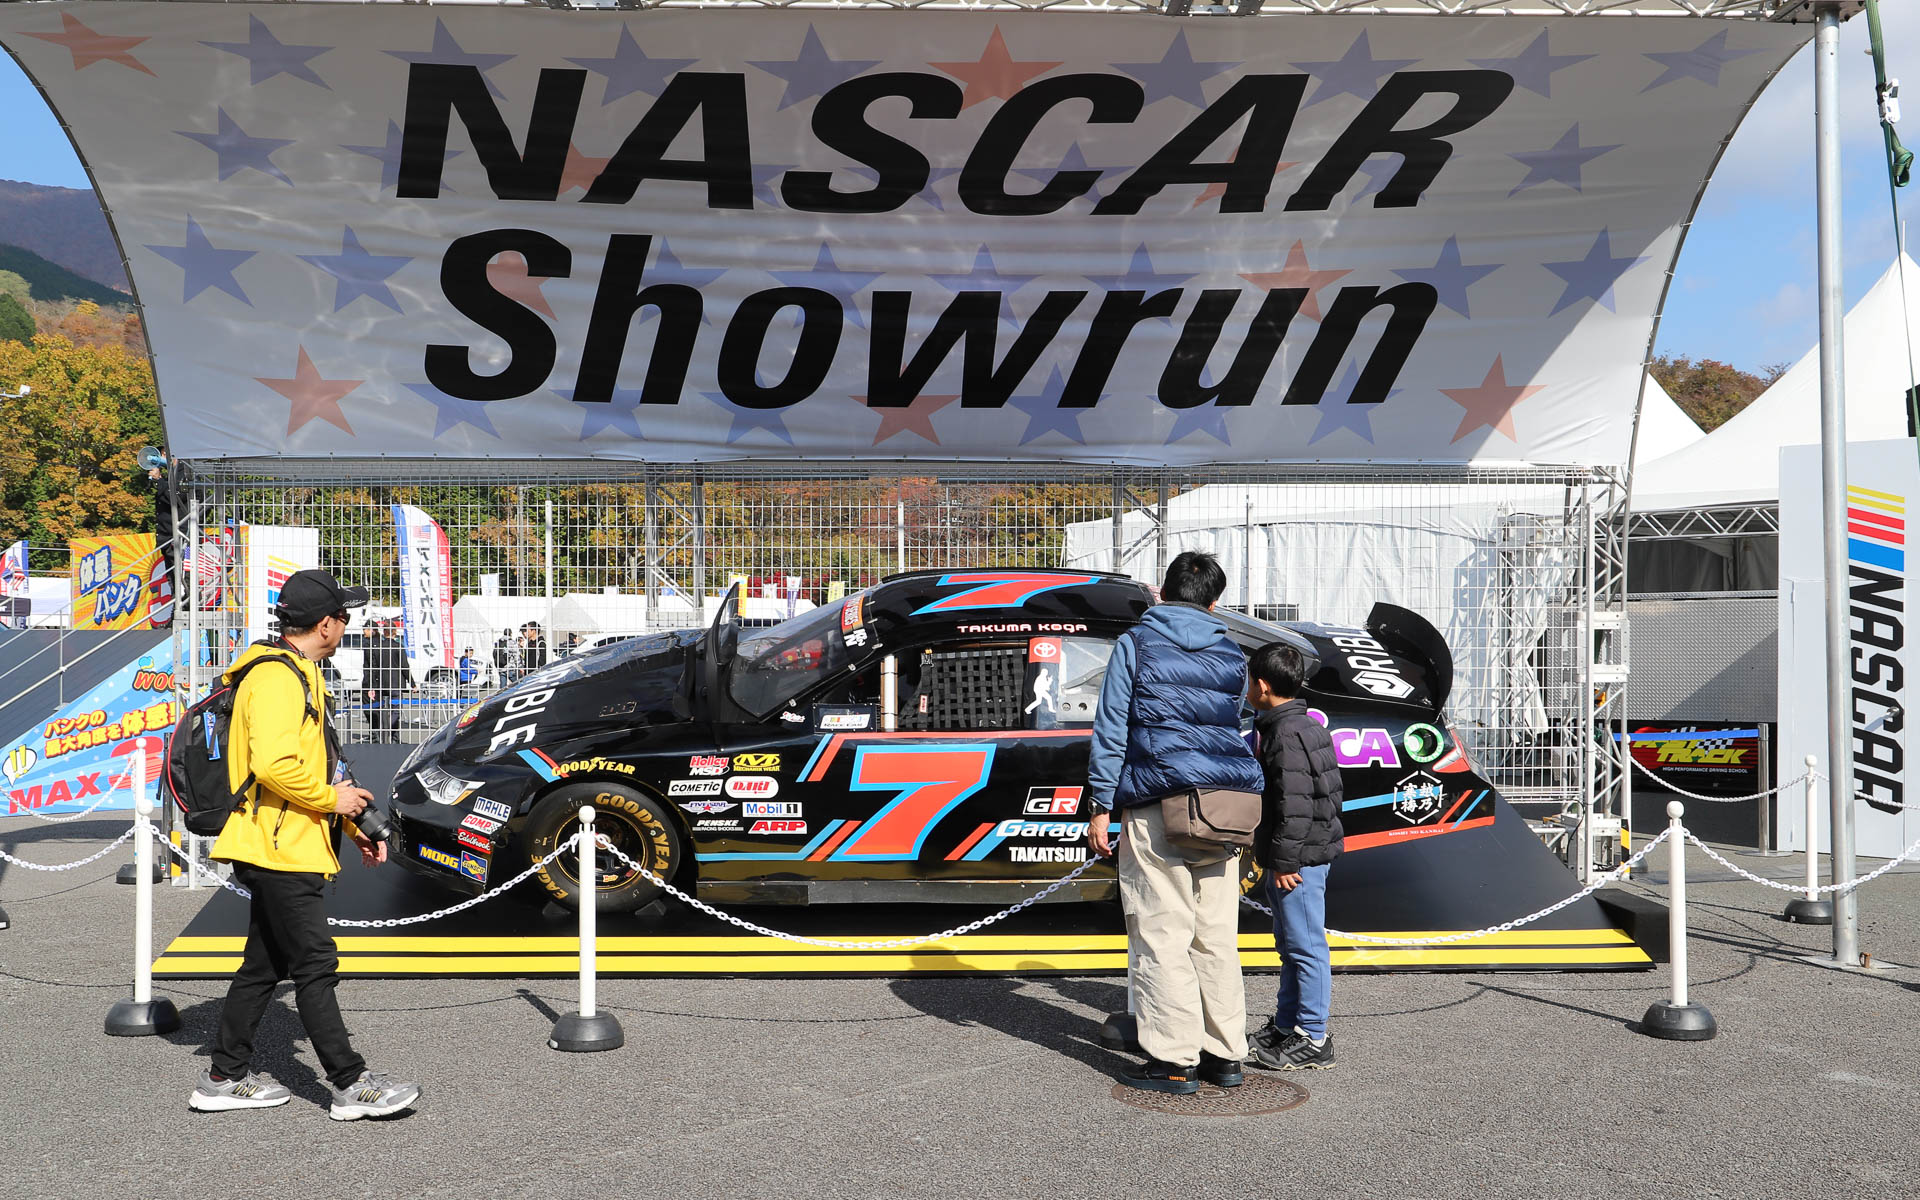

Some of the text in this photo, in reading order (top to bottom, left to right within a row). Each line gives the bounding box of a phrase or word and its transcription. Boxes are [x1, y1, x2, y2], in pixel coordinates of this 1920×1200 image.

[396, 62, 1514, 216] NASCAR
[424, 228, 1439, 410] Showrun
[909, 572, 1100, 616] 7
[957, 623, 1032, 633] TAKUMA
[1849, 565, 1904, 815] NASCAR
[43, 709, 108, 739] バンクの
[690, 755, 729, 768] Holley
[1656, 748, 1749, 764] TRACK
[551, 758, 636, 777] GOODYEAR
[689, 767, 725, 776] MSD
[9, 771, 102, 815] MAX
[826, 743, 998, 862] 7
[475, 797, 510, 821] MAHLE
[746, 803, 783, 813] Mobil
[1026, 797, 1077, 813] GR
[464, 815, 492, 830] COMP
[752, 821, 806, 831] ARP
[458, 832, 491, 851] Edelbrock
[420, 846, 460, 869] MOOG
[1008, 846, 1087, 863] TAKATSUJI
[463, 861, 486, 874] SUNOCO
